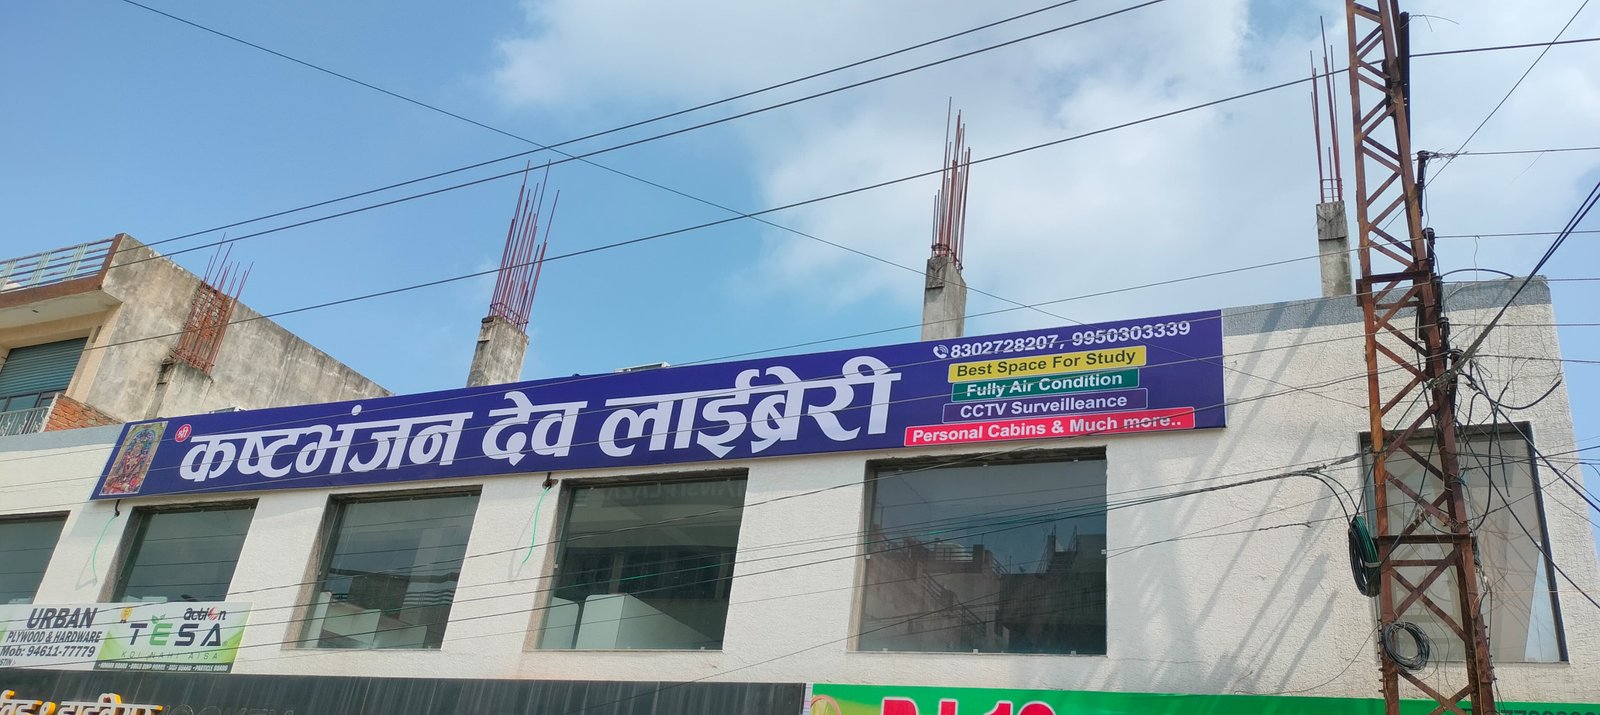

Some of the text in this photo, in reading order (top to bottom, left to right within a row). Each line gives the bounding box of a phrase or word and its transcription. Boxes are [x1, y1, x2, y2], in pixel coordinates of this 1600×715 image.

[950, 320, 1191, 359] 8302728207, 9950303339
[957, 350, 1136, 377] Best Space For Study
[966, 374, 1123, 398] Fully Air Condition
[179, 356, 902, 482] कष्टभंजन देव लाईब्रेरी
[960, 396, 1128, 418] CCTV Surveilleance
[912, 417, 1182, 443] Personal Cabins & Much more..
[26, 607, 98, 629] URBAN
[6, 631, 103, 643] PLYWOOD & HARDWARE
[129, 623, 222, 647] TESA
[0, 645, 96, 657] Mob: 94611-77779
[188, 652, 219, 660] AISA
